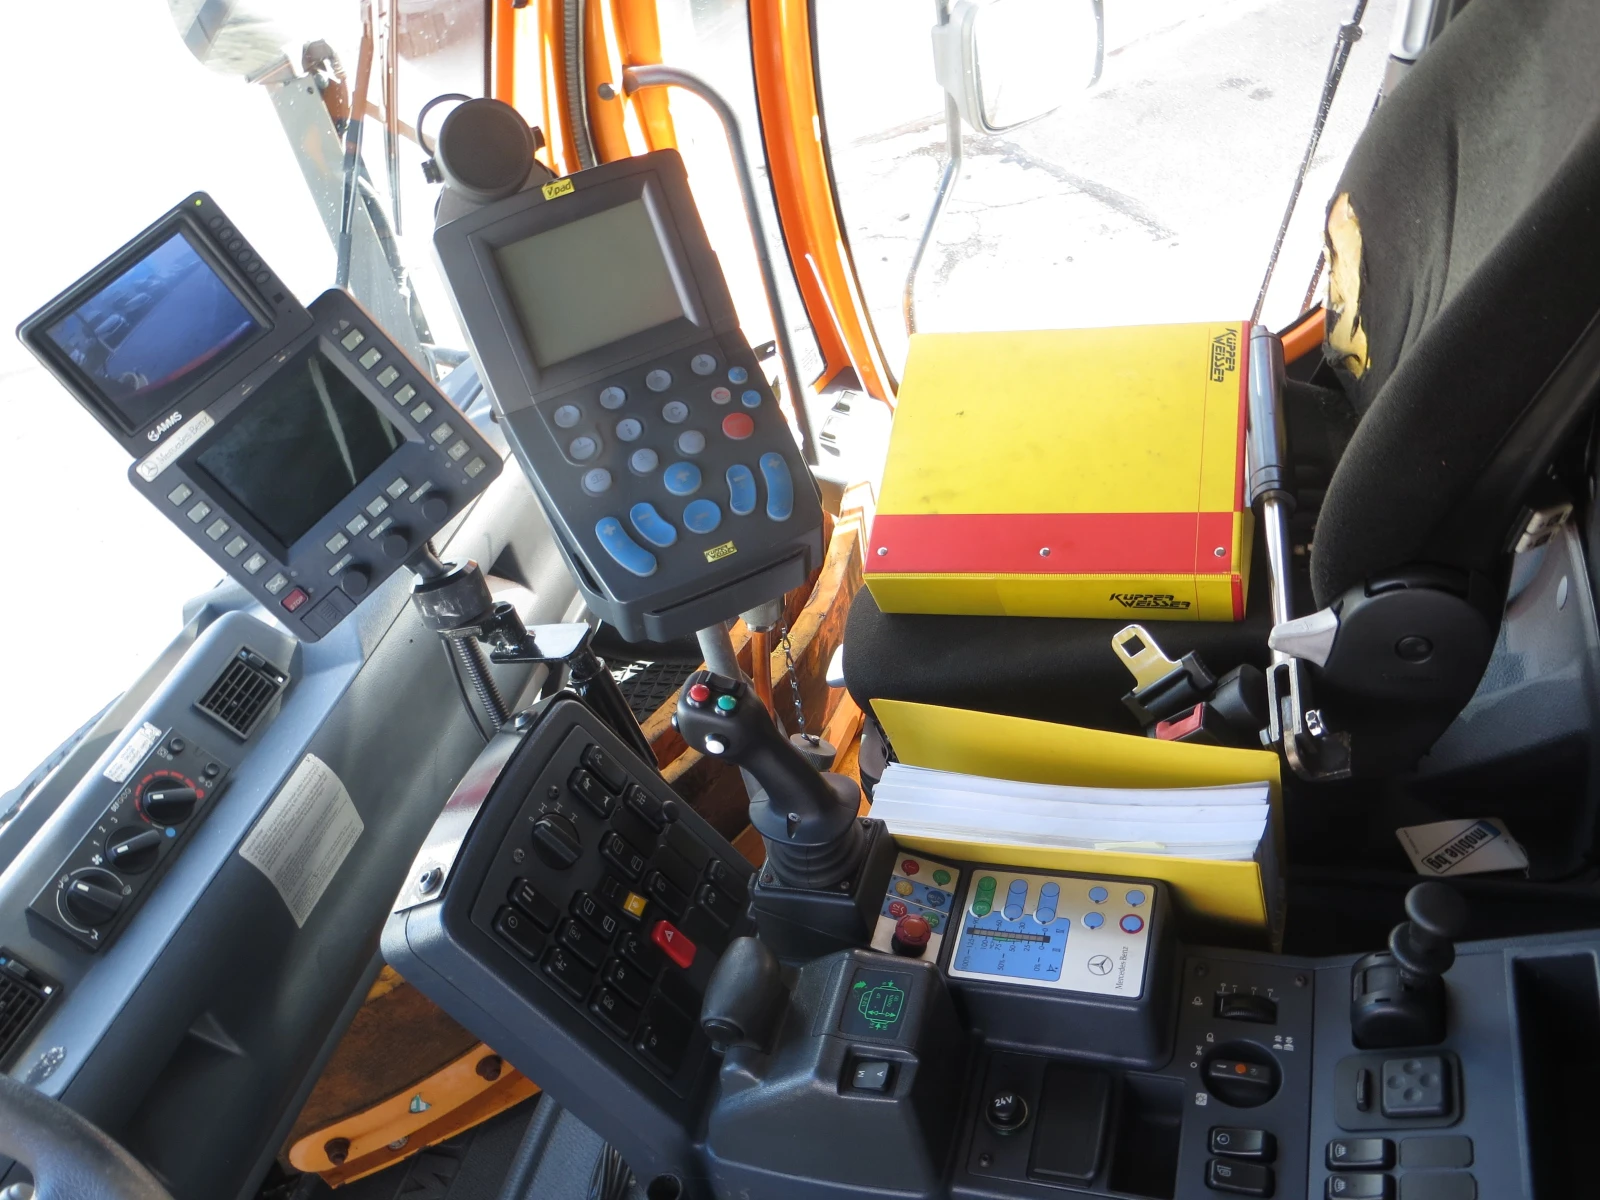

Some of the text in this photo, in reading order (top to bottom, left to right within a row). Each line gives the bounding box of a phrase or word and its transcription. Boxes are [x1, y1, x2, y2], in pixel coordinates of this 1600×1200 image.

[290, 595, 304, 609] STOP
[1426, 828, 1489, 870] mobile.bg
[1115, 946, 1129, 990] Mercedes Benz
[857, 1070, 865, 1078] M
[995, 1095, 1013, 1107] 24V
